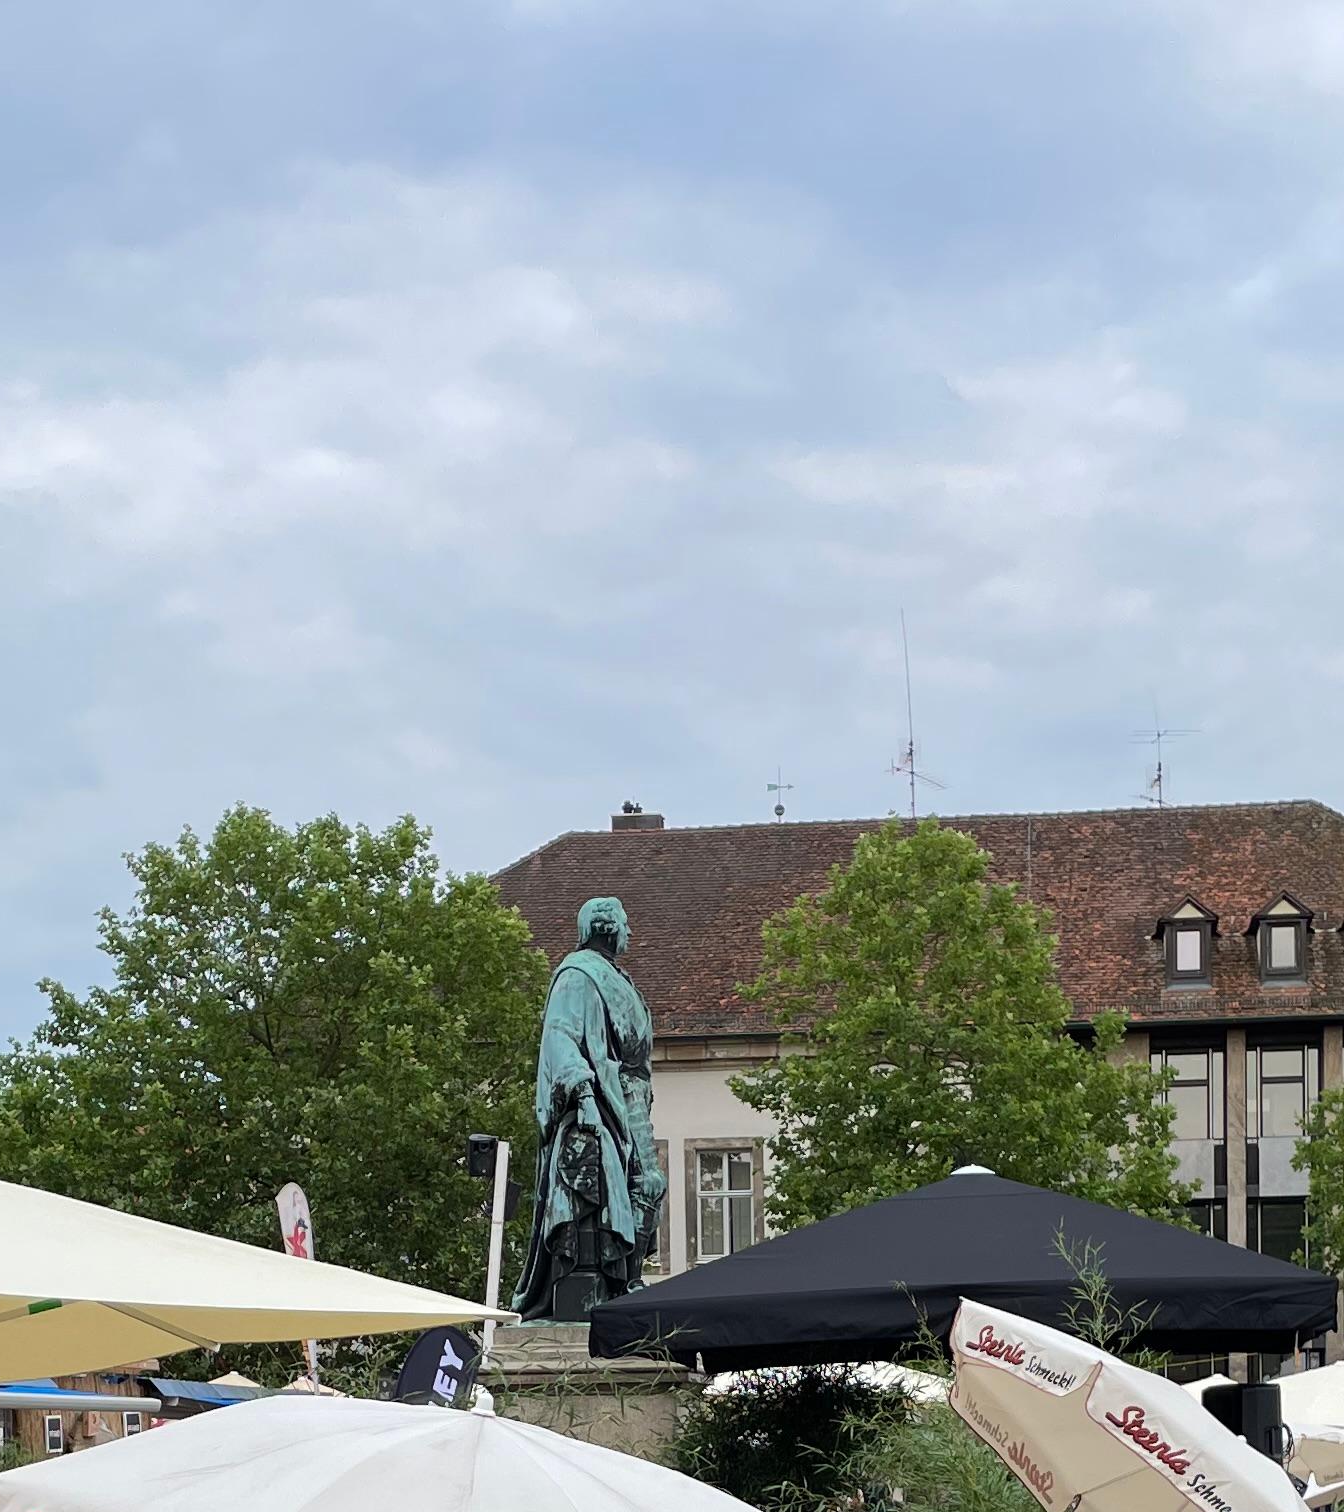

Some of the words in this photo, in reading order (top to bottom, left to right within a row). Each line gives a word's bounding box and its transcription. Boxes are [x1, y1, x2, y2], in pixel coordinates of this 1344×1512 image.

[966, 1325, 1027, 1366] Sternla
[1025, 1355, 1077, 1391] Schmeckt!
[1106, 1405, 1191, 1476] Sternla
